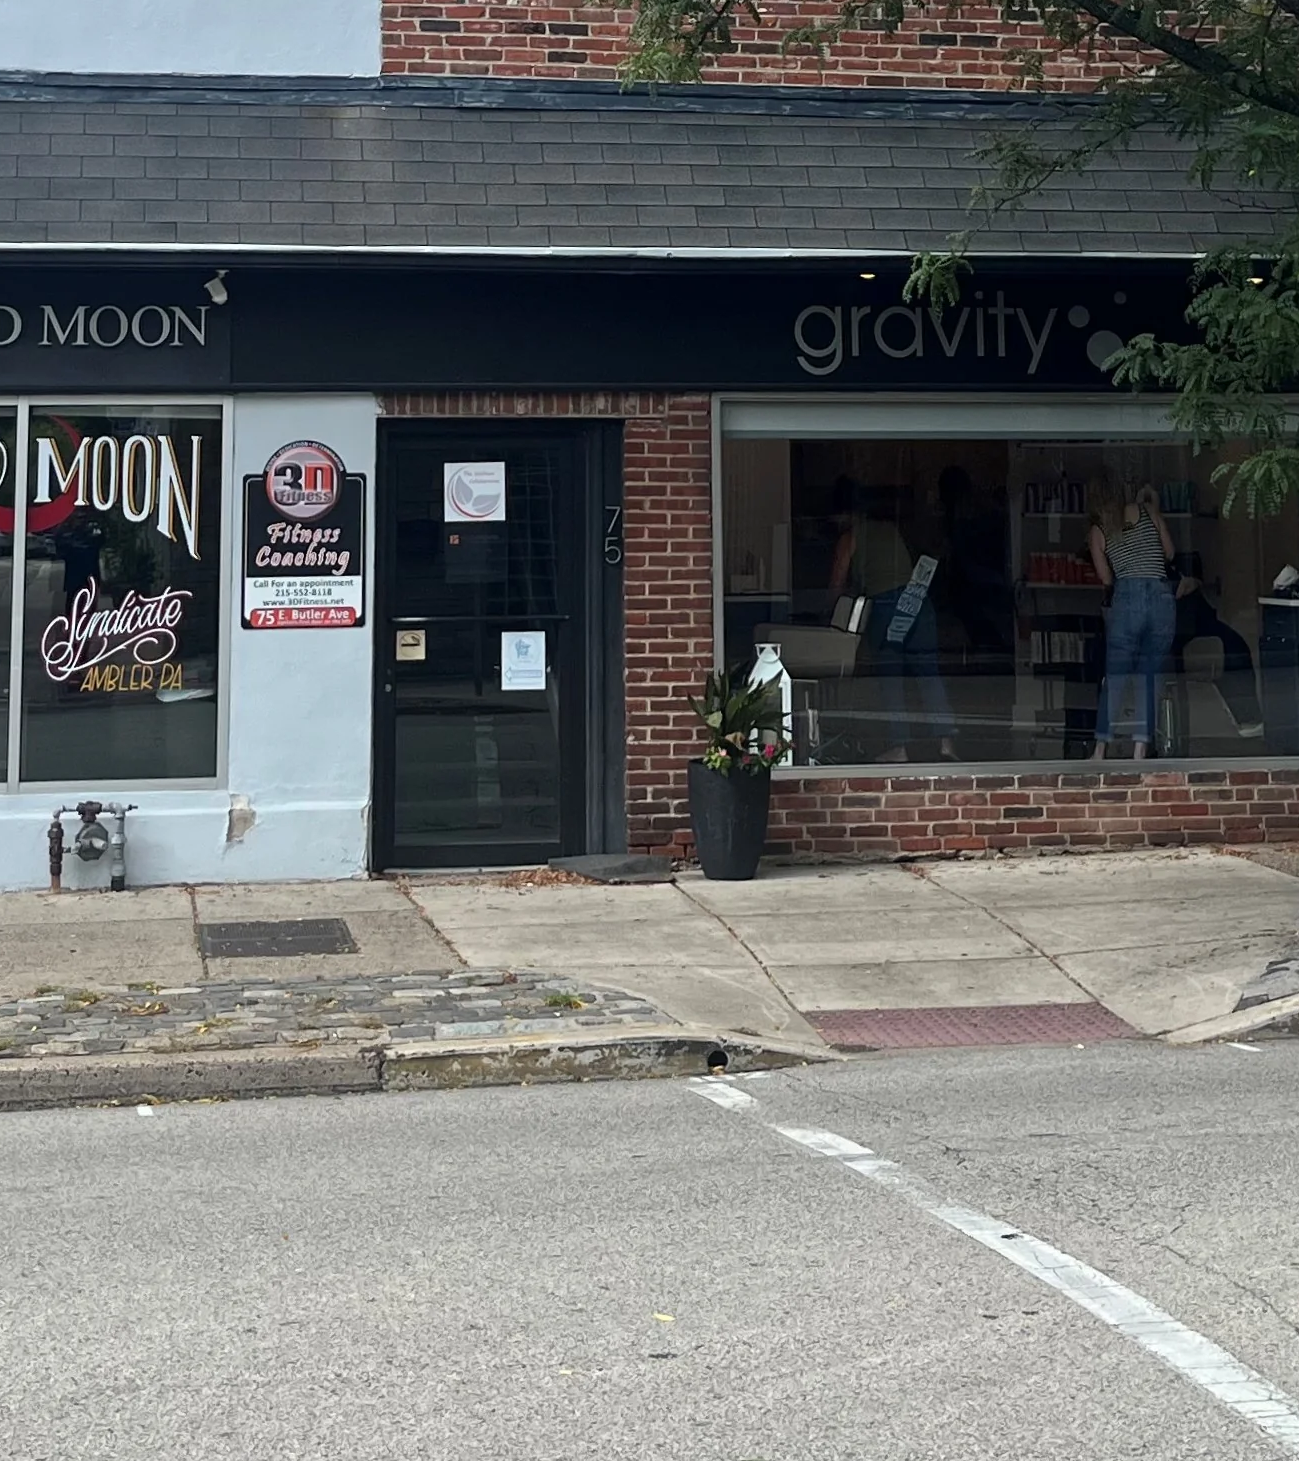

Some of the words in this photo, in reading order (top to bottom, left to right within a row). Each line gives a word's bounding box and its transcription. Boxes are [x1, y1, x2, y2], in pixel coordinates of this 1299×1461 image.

[38, 304, 211, 347] MOON
[794, 290, 1058, 376] gravity
[33, 434, 202, 561] MOON
[274, 461, 335, 506] 3D
[267, 522, 341, 544] Fitness
[605, 506, 622, 564] 75
[255, 541, 351, 576] Coaching
[253, 580, 269, 588] Call
[299, 579, 354, 589] appointment
[40, 576, 193, 682] Syndicate
[256, 610, 275, 625] 75
[278, 610, 289, 620] E.
[291, 609, 326, 620] Butler
[328, 609, 350, 619] Ave
[79, 663, 153, 693] AMBLER
[158, 662, 183, 692] PA
